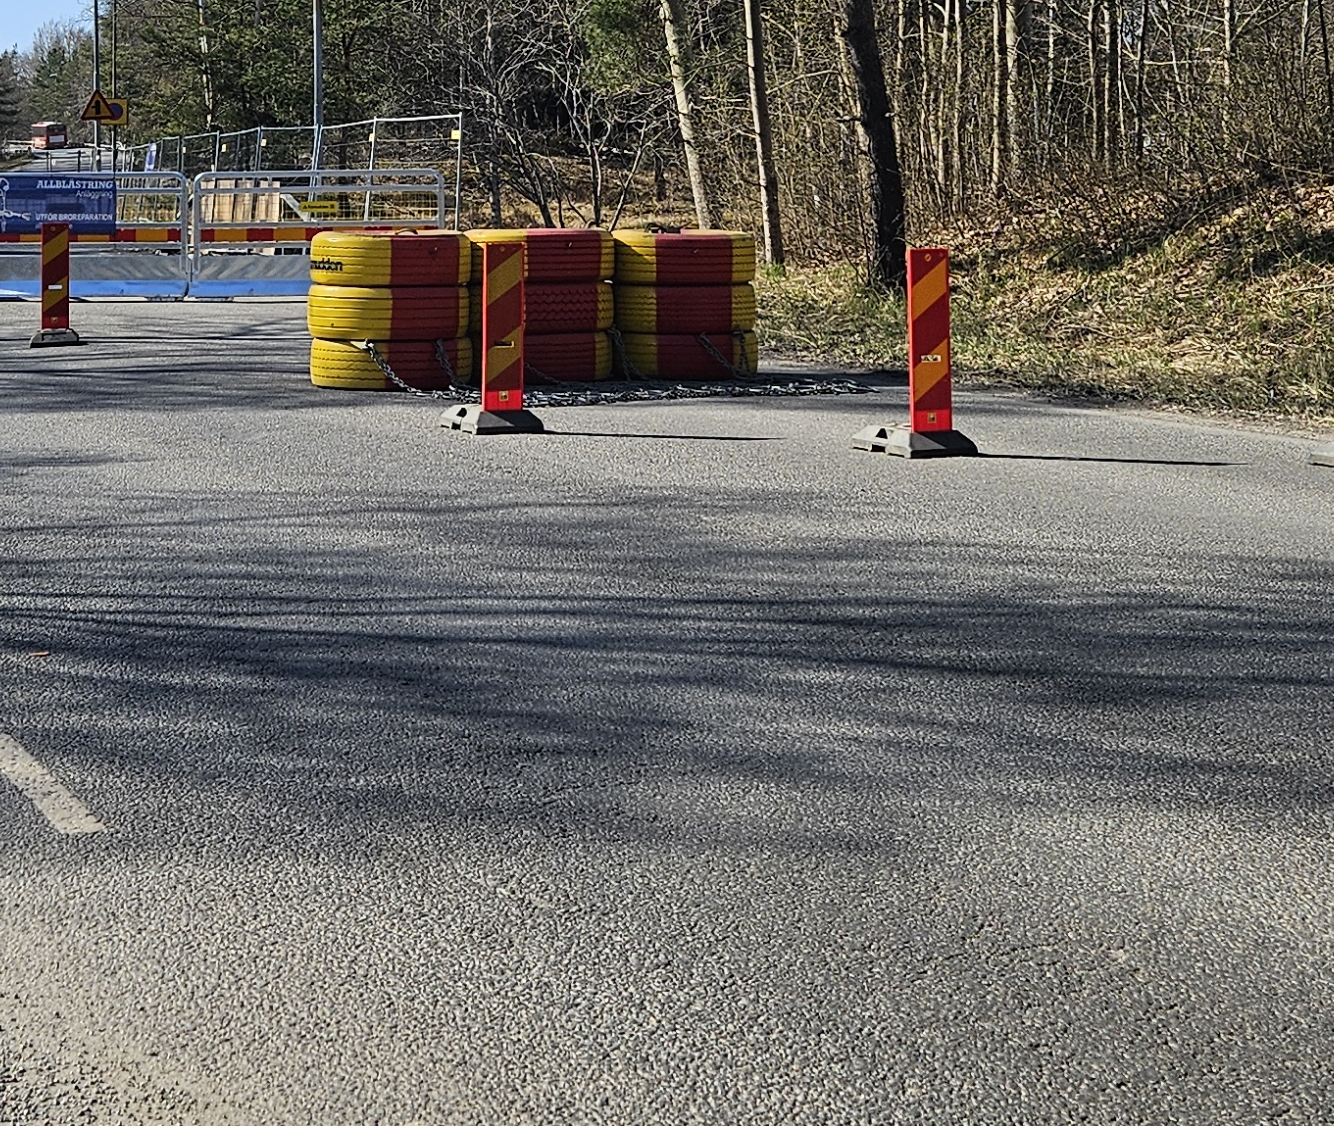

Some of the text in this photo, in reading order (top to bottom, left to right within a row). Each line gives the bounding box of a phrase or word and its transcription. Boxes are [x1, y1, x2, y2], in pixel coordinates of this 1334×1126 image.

[36, 178, 114, 189] ALLBLÄSTRING
[75, 190, 113, 199] Anläggning
[35, 213, 113, 221] UTFÖR BROREPARATION
